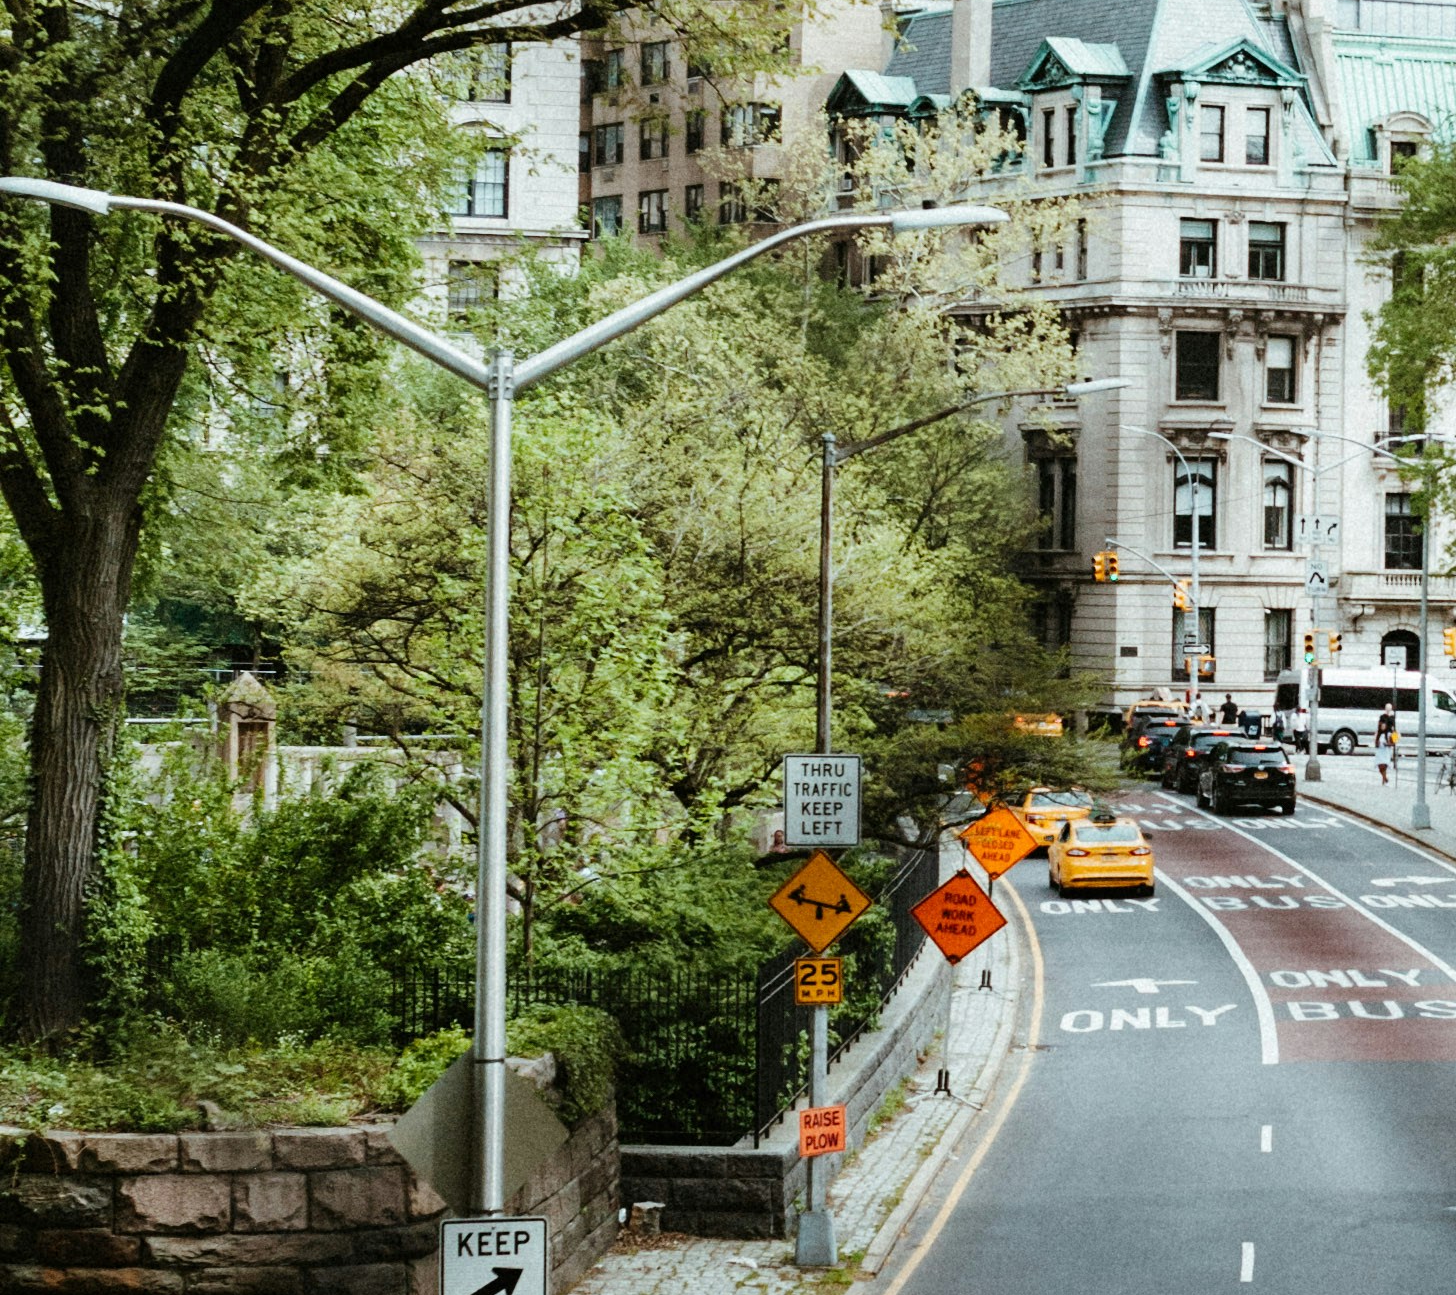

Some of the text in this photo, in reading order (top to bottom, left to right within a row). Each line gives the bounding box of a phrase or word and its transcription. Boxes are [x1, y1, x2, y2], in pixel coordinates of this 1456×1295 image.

[801, 763, 845, 777] THRU
[793, 782, 852, 797] TRAFFIC
[801, 801, 844, 816] KEEP
[801, 821, 843, 836] LEFT
[1139, 819, 1225, 831] US
[1231, 817, 1346, 829] ONLY
[981, 851, 1011, 863] AHEAD
[1183, 875, 1306, 889] ONLY
[943, 892, 977, 907] ROAD
[1040, 898, 1160, 915] ONLY
[1200, 895, 1348, 910] BUS
[941, 908, 975, 922] WORK
[936, 922, 977, 937] AHEAD
[800, 963, 838, 986] 25
[1269, 969, 1422, 988] ONLY
[1059, 1004, 1239, 1032] ONLY
[803, 1110, 841, 1130] RAISE
[805, 1132, 839, 1152] PLOW
[457, 1230, 531, 1257] KEEP
